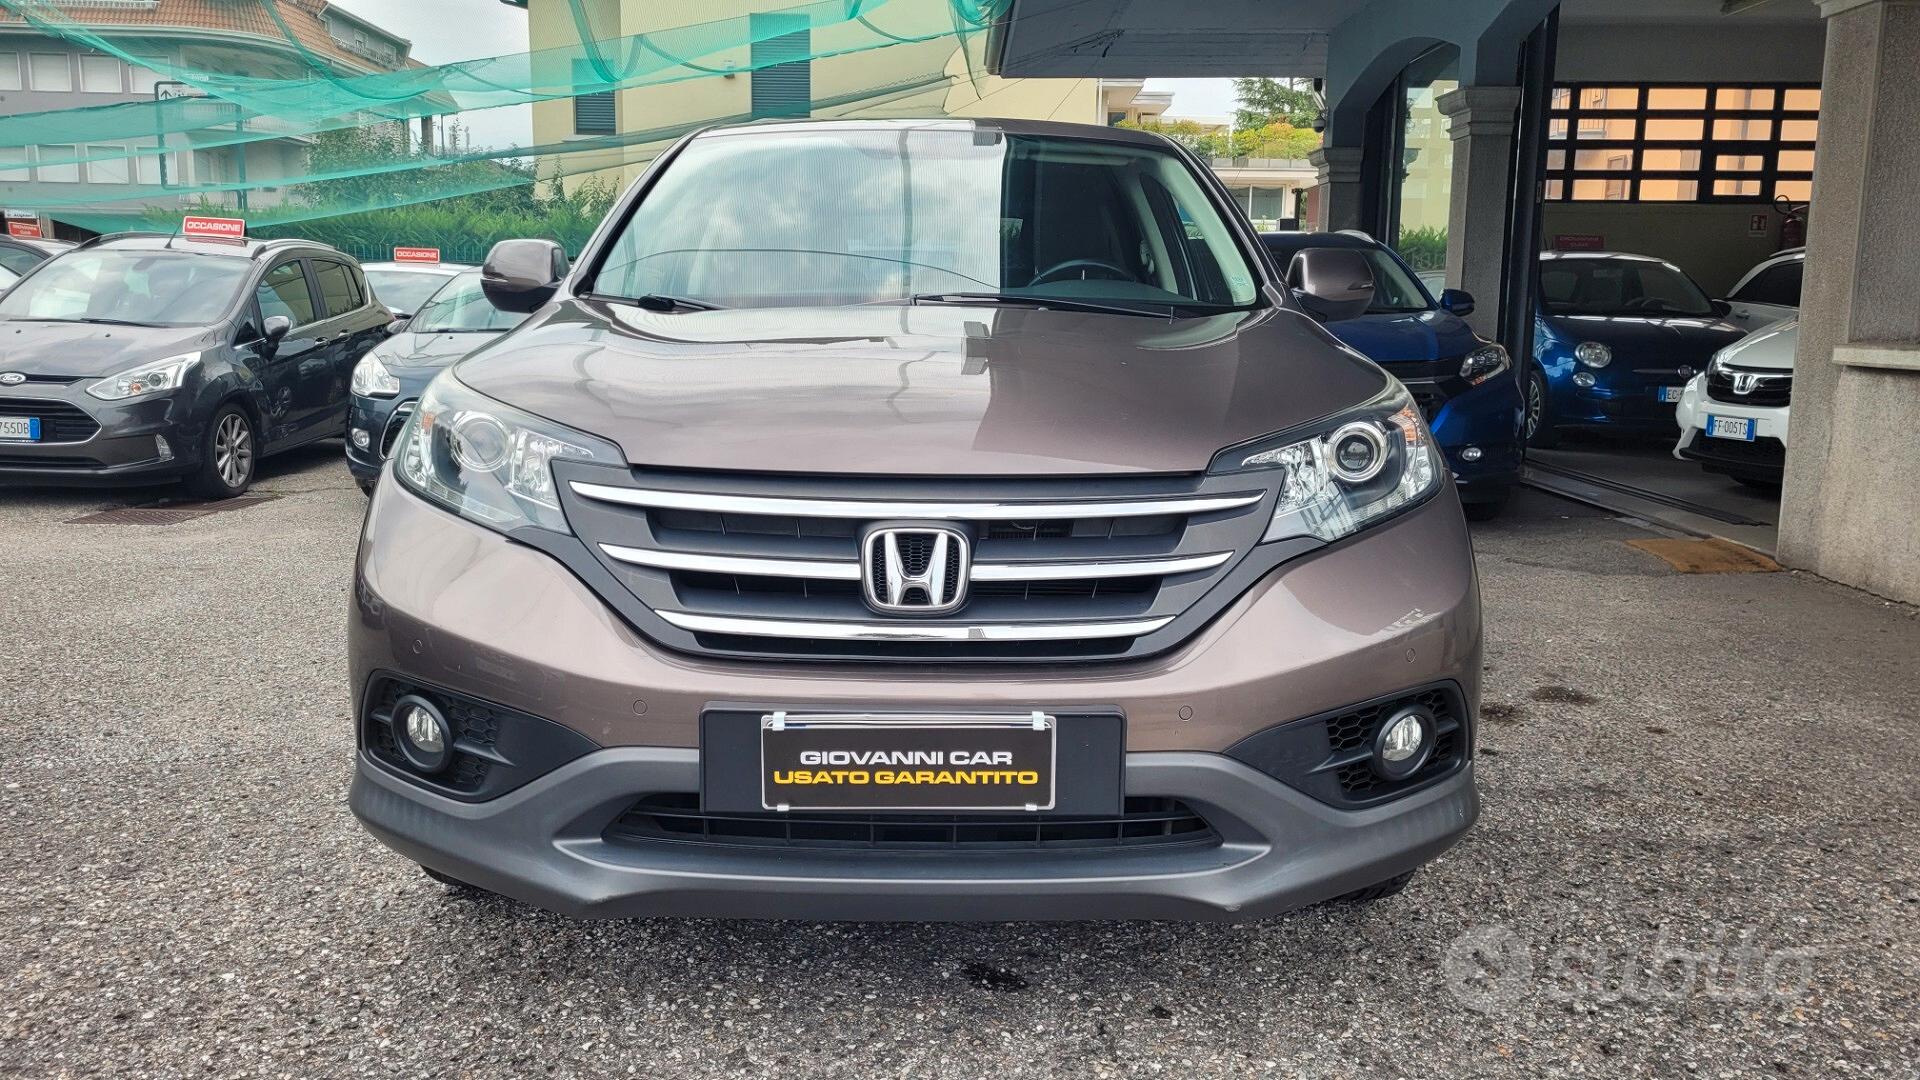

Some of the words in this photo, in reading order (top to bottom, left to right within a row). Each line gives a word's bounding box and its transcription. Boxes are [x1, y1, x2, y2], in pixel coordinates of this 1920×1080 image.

[187, 221, 241, 232] OCCASIONE
[396, 250, 437, 259] OCCASIONE
[800, 751, 943, 765] GIOVANNI
[949, 751, 1013, 765] CAR
[774, 770, 870, 785] USATO
[874, 770, 1039, 785] GARANTITO
